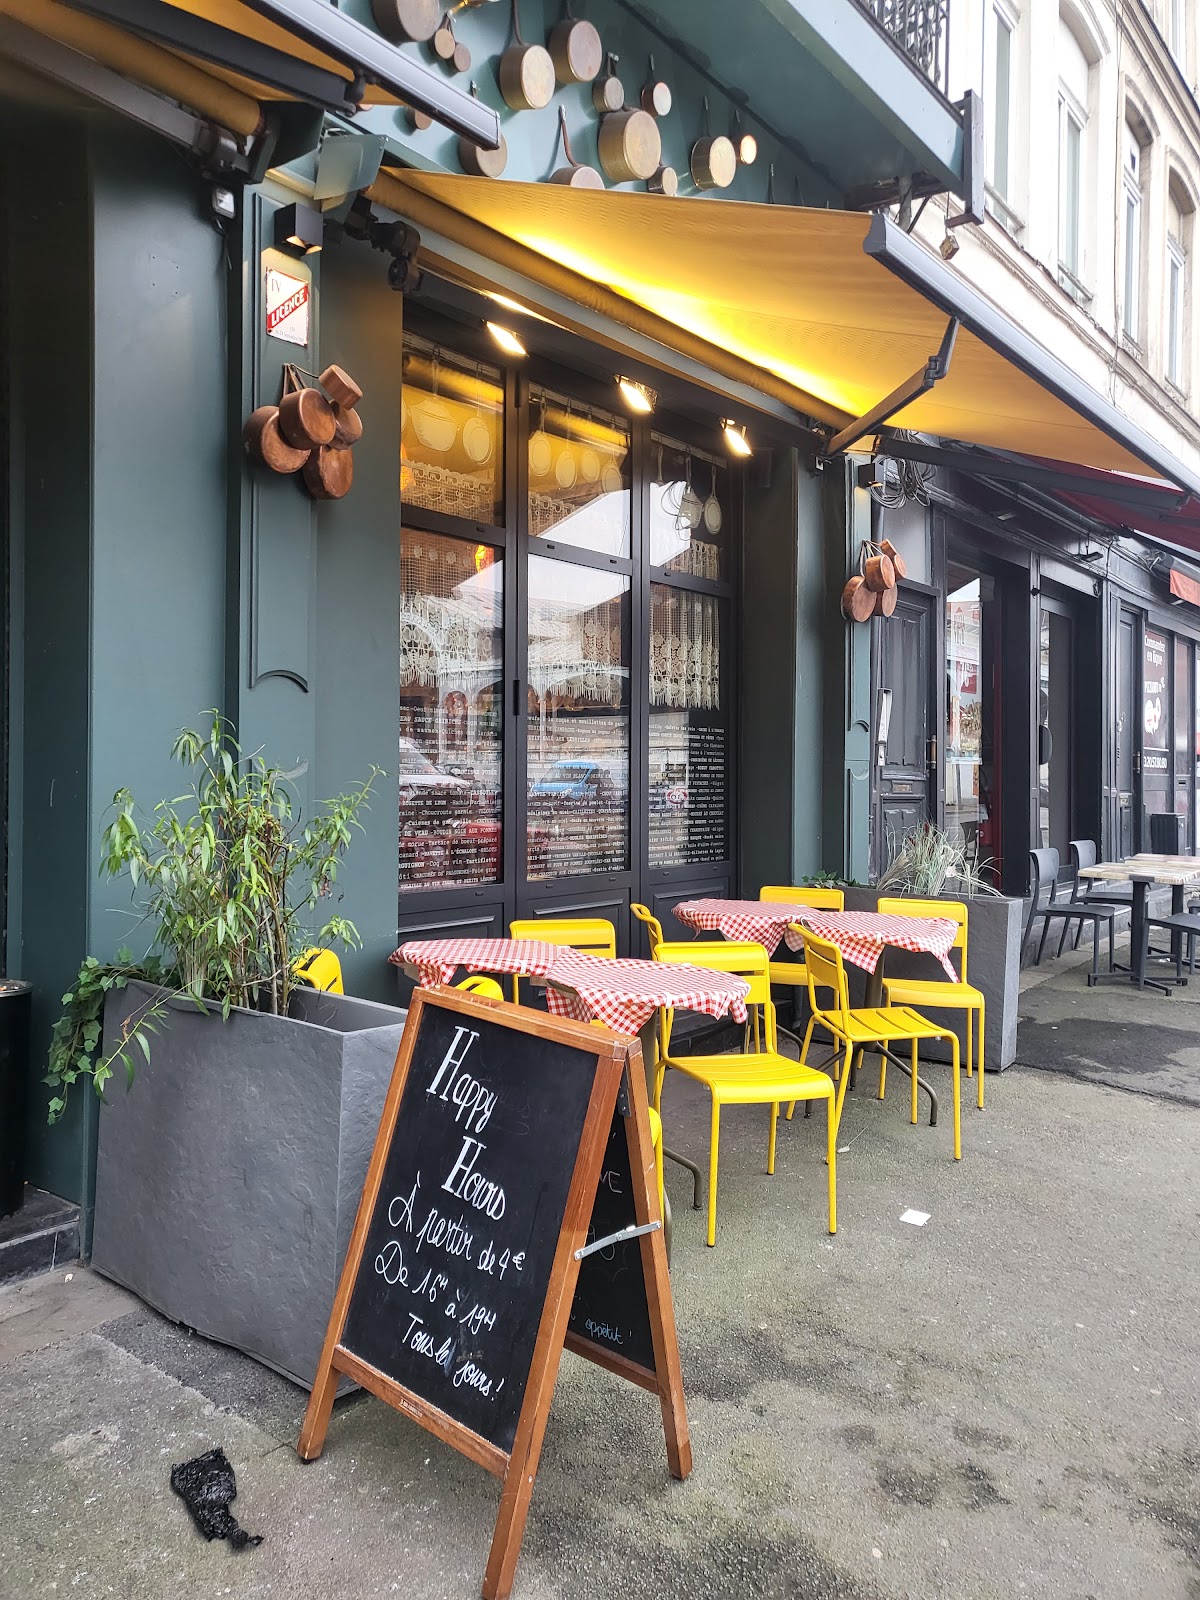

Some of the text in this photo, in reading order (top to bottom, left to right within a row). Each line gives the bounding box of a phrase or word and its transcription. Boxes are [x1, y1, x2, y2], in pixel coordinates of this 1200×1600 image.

[271, 289, 305, 327] LICENCE
[1144, 635, 1166, 653] Commandez
[1147, 651, 1163, 667] en ligne
[426, 1025, 498, 1133] Happy
[441, 1136, 506, 1220] Hours
[388, 1170, 421, 1233] À
[477, 1240, 496, 1275] de
[374, 1240, 409, 1288] De
[444, 1288, 461, 1319] à
[402, 1312, 434, 1358] Tous
